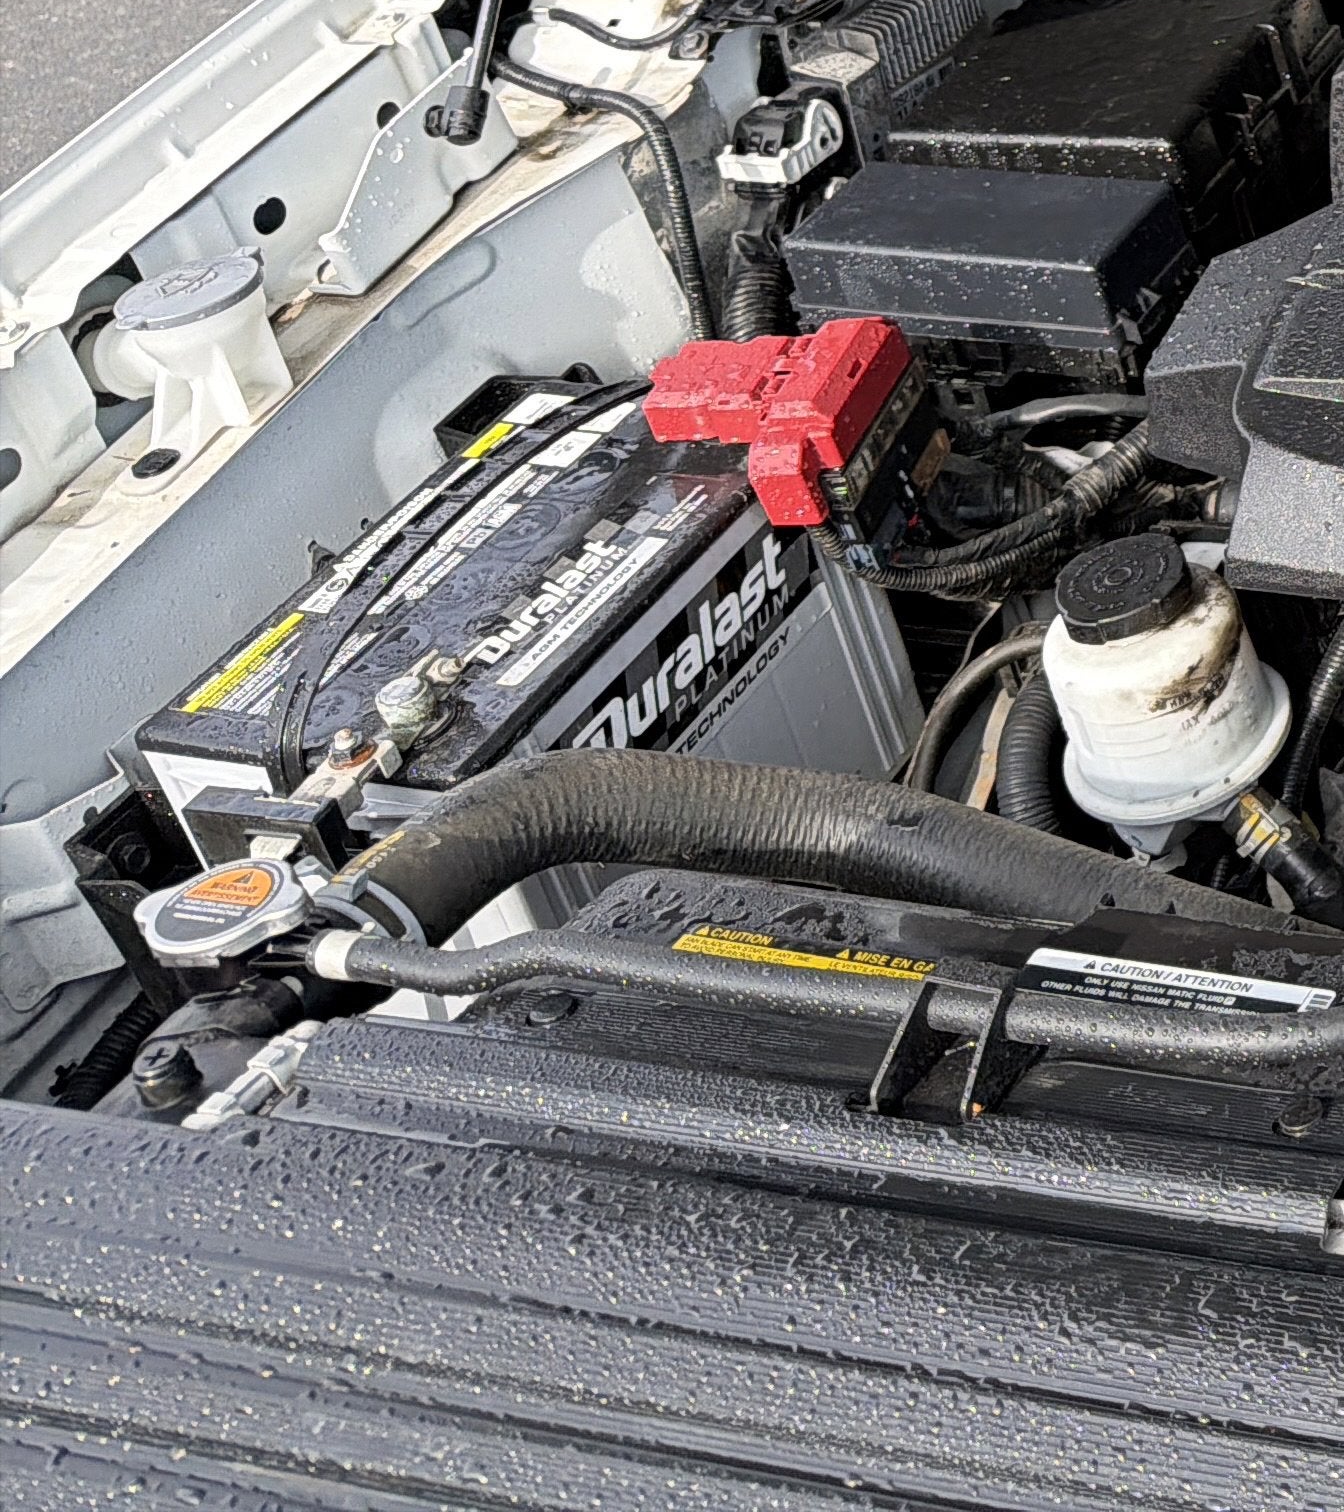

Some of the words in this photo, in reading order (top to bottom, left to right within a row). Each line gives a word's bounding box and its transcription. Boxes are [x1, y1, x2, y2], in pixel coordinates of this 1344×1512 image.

[460, 539, 617, 670] Duralast
[531, 633, 561, 662] AGM
[560, 558, 639, 631] TECHNOLOGY
[543, 545, 630, 626] PLATINUM
[573, 533, 787, 750] Duralast
[674, 583, 790, 723] PLATINUM
[675, 626, 791, 755] TECHNOLOGY
[710, 928, 774, 946] CAUTION
[853, 951, 891, 966] MISE
[889, 956, 914, 970] EN
[1100, 962, 1165, 980] CAUTION
[1172, 973, 1254, 993] ATTENTION
[1040, 980, 1073, 992] OTHER
[1073, 984, 1107, 997] FLUIDS
[1107, 989, 1129, 1001] WILL
[1130, 993, 1172, 1007] DAMAGE
[1172, 999, 1193, 1010] THE
[1084, 976, 1111, 987] ONLY
[1110, 979, 1131, 990] USE
[1131, 982, 1168, 995] NISSAN
